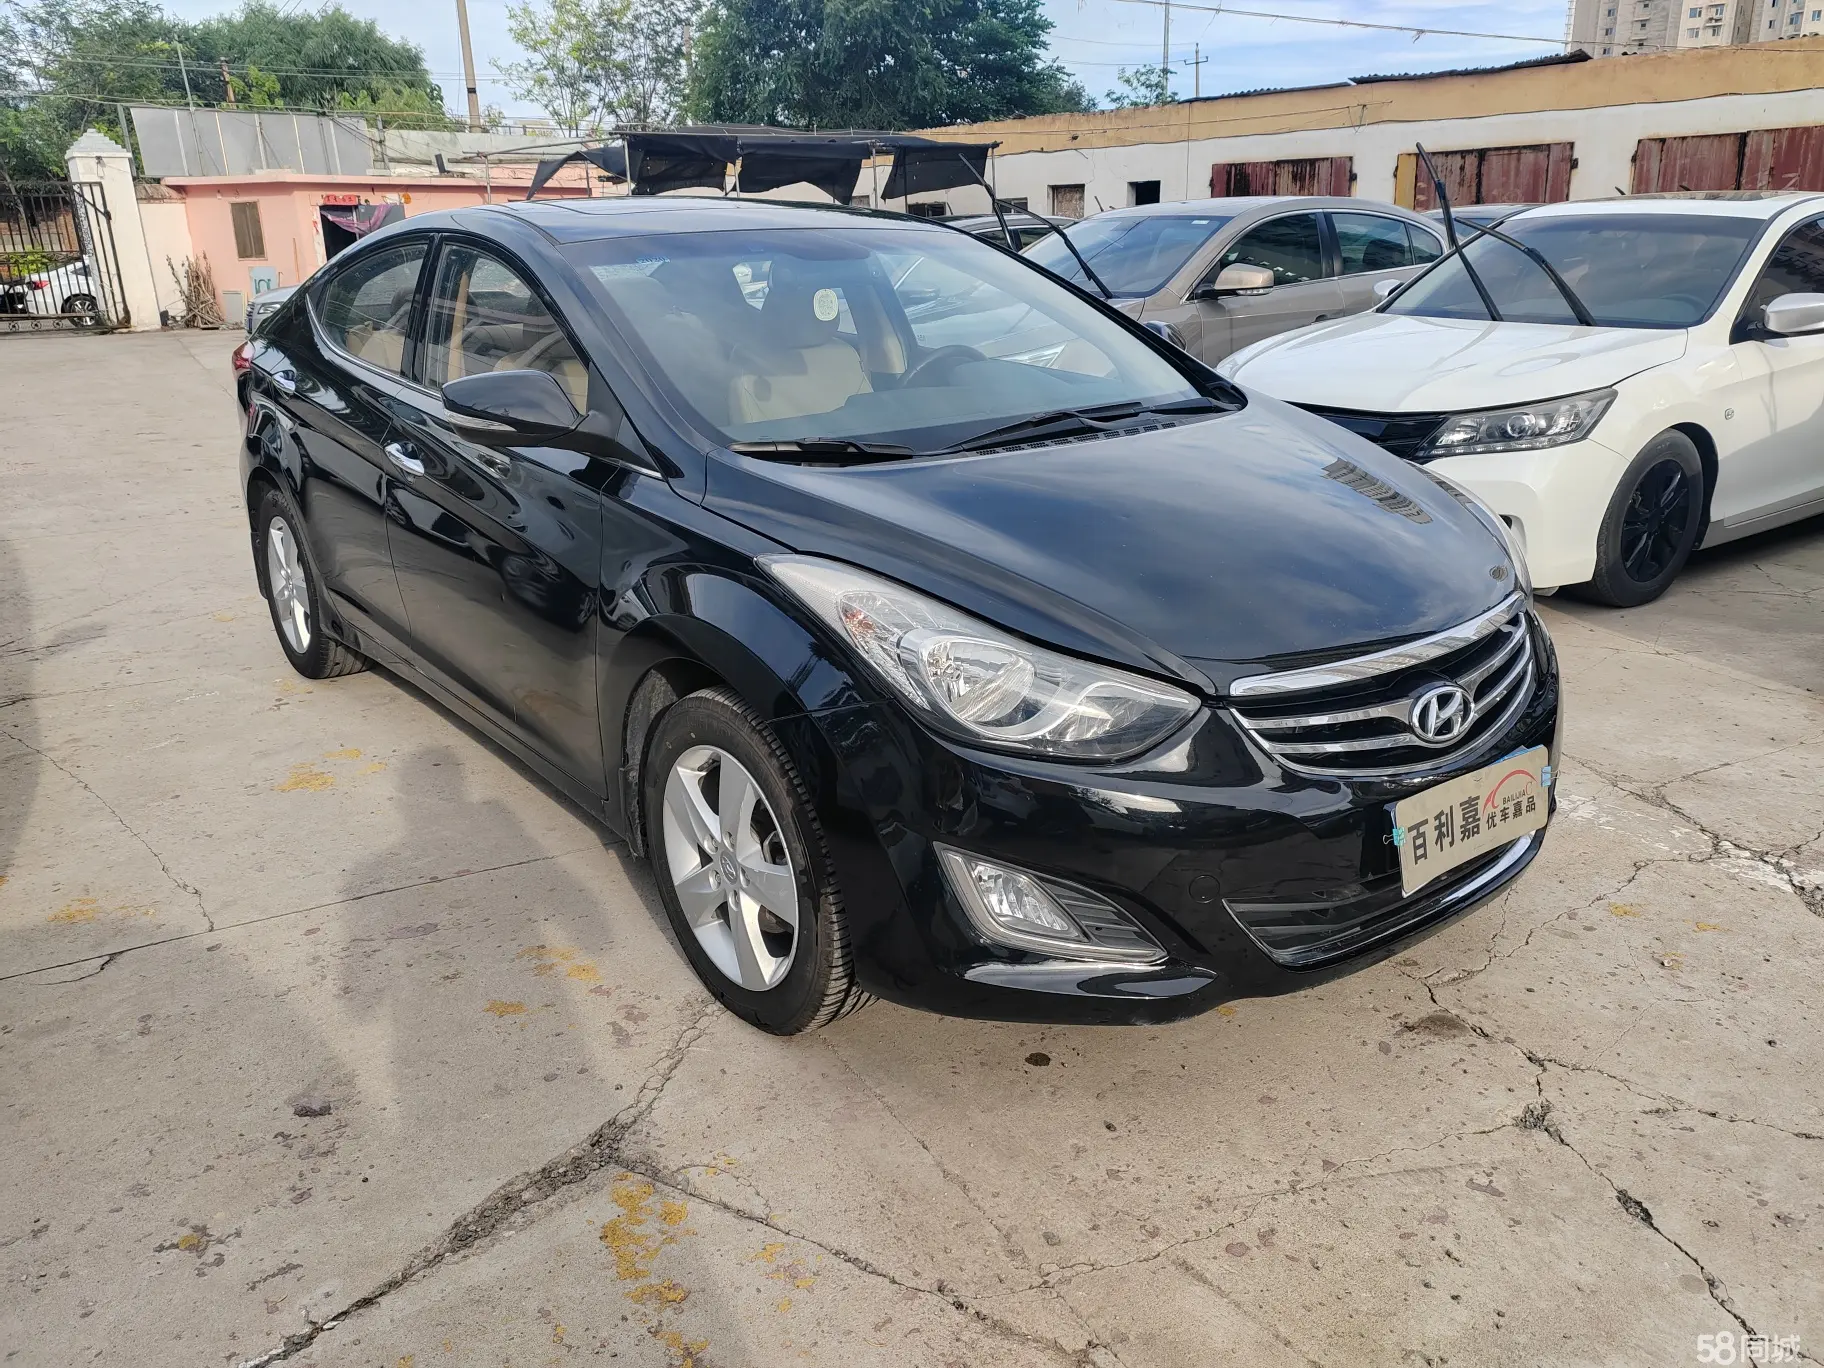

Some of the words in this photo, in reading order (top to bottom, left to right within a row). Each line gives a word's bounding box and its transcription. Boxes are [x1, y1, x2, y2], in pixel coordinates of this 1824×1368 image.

[1407, 795, 1480, 865] 百利嘉
[1486, 795, 1536, 831] 优车嘉品
